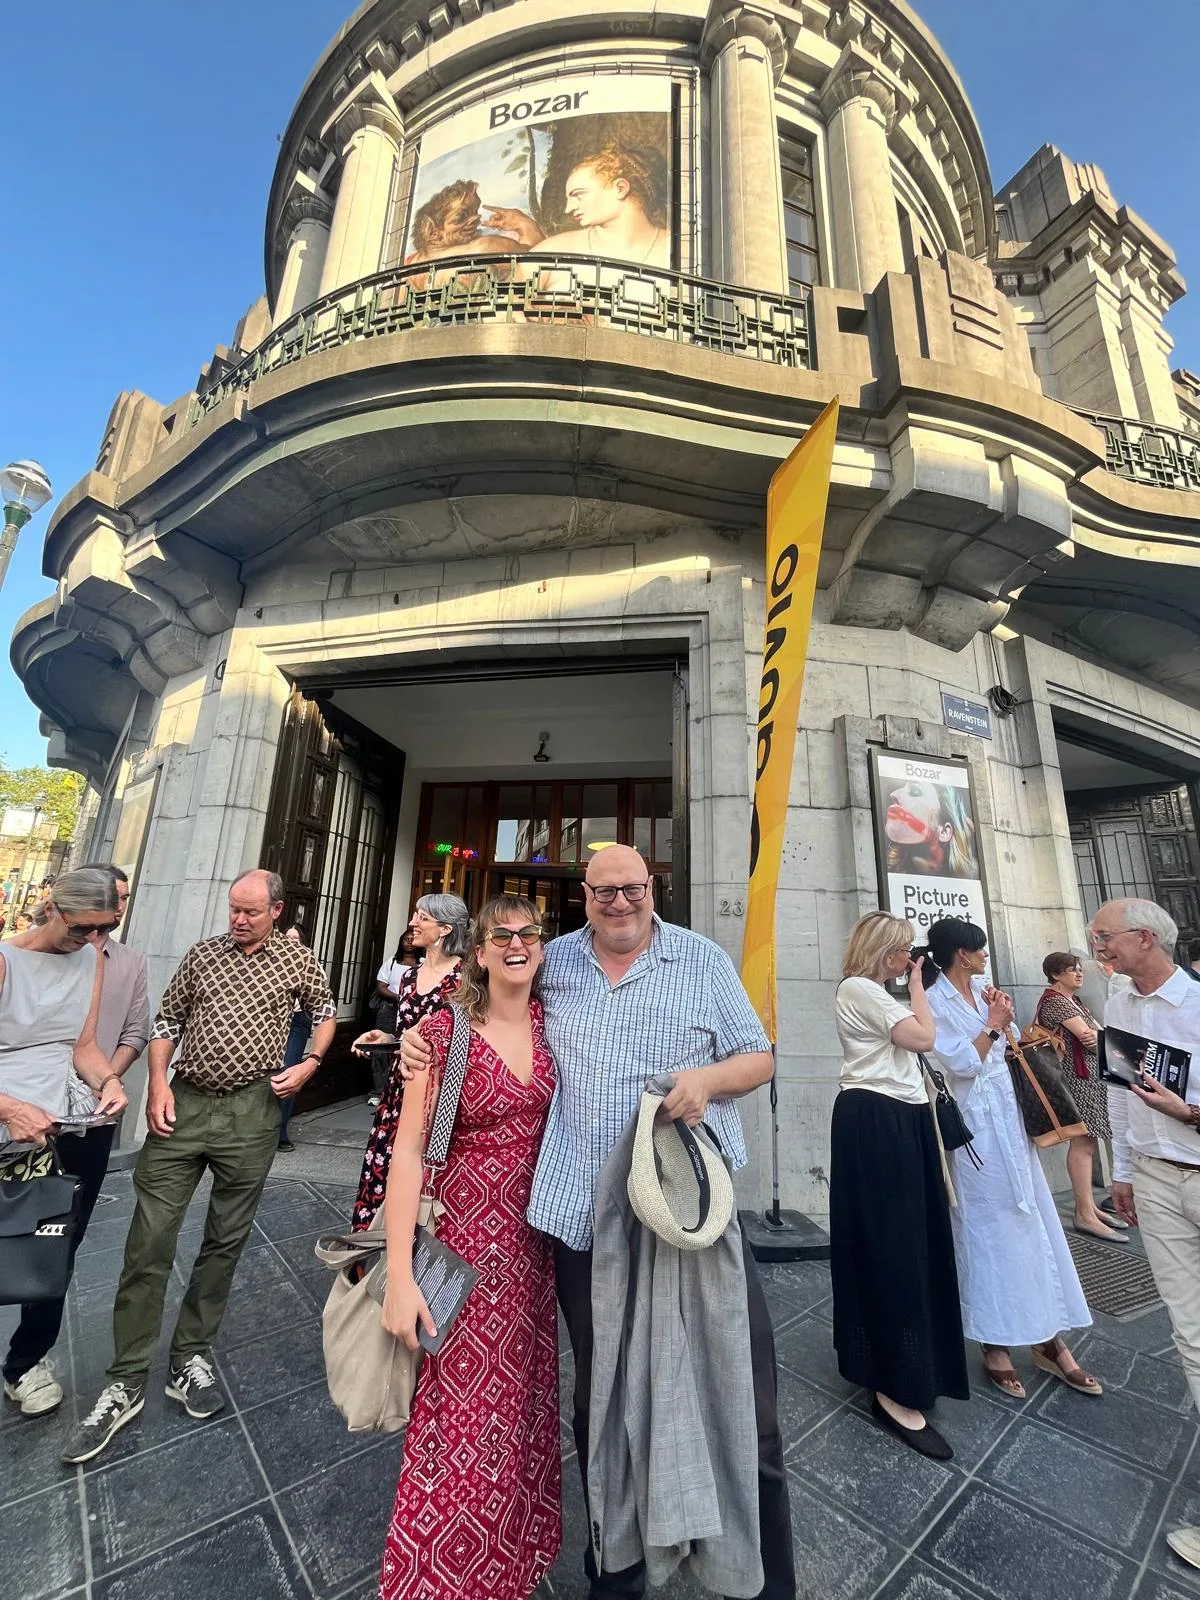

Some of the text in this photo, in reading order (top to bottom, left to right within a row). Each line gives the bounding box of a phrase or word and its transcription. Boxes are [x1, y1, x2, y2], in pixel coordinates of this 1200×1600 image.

[489, 90, 589, 130] Bozar
[948, 709, 987, 728] RAVENSTEIN
[905, 763, 942, 780] Bozar
[903, 884, 969, 908] Picture
[719, 898, 745, 916] 23
